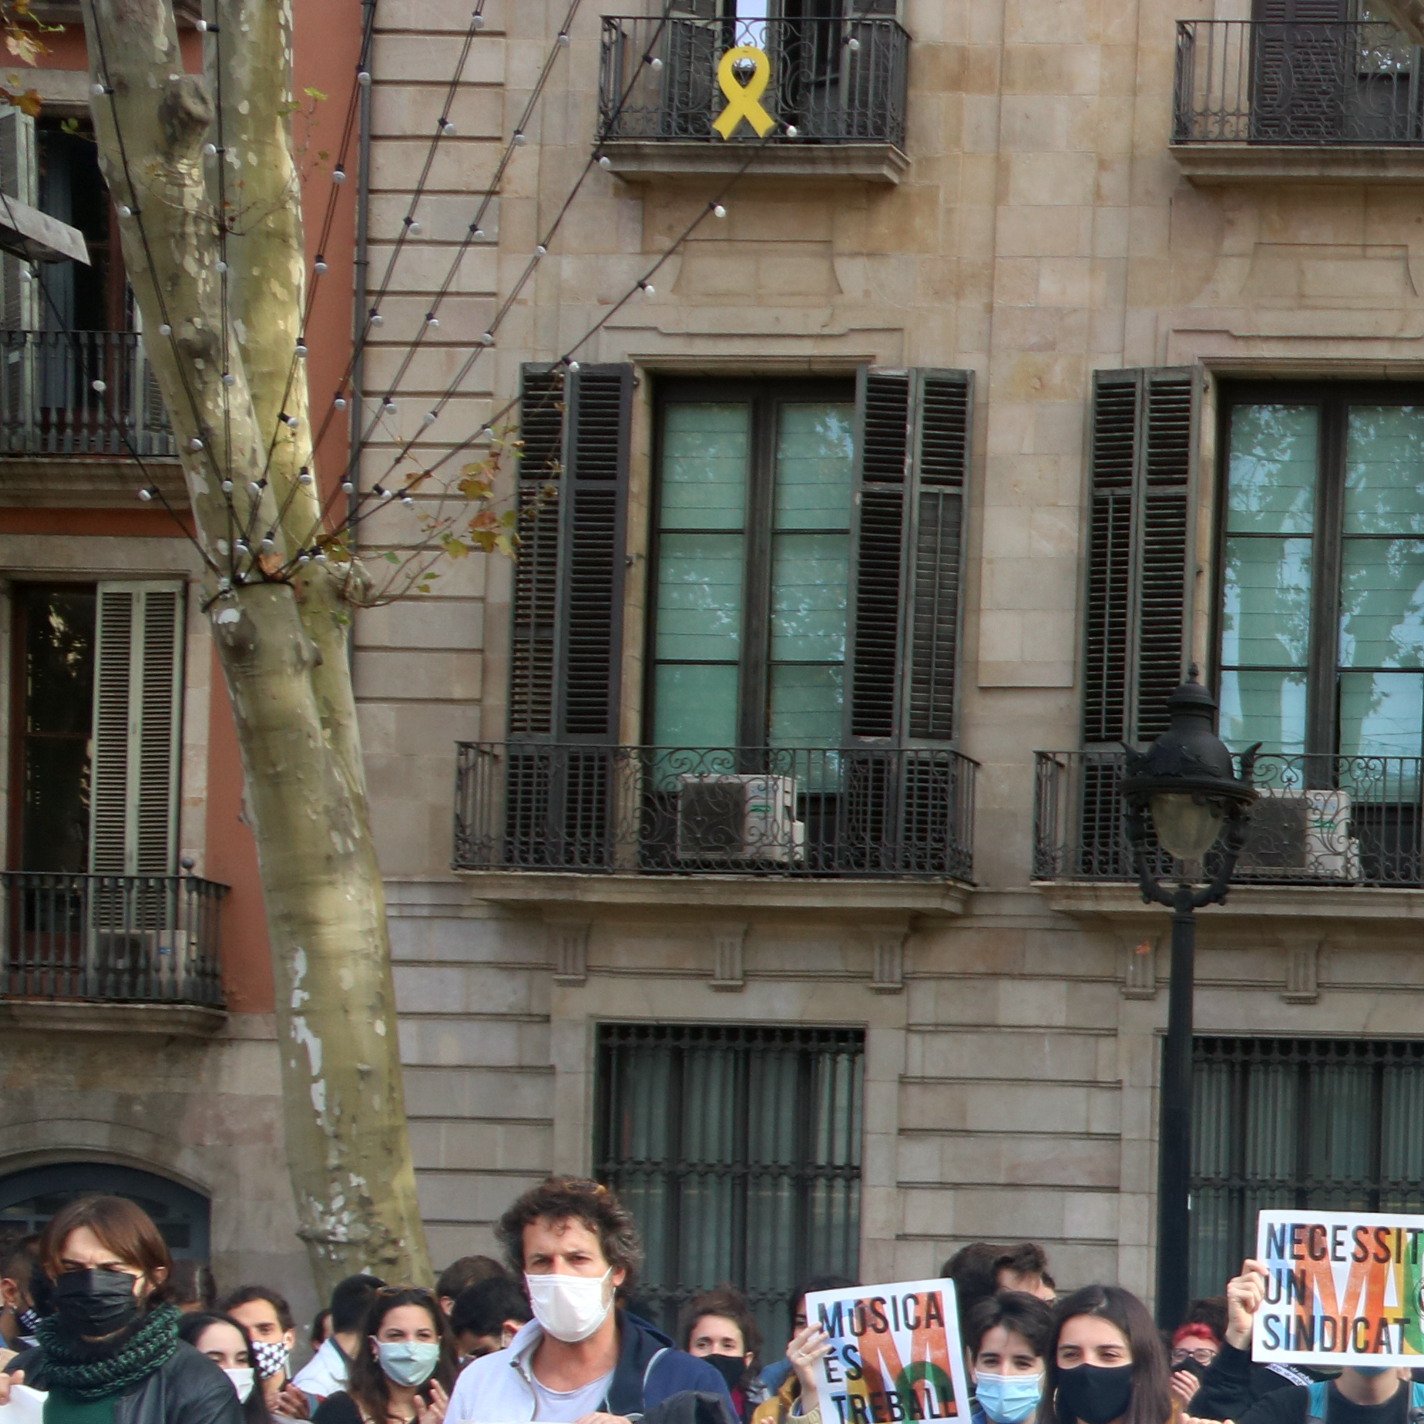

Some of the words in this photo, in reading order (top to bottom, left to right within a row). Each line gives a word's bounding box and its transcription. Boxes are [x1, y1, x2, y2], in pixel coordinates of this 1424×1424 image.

[1265, 1268, 1306, 1305] UN
[1262, 1314, 1411, 1354] SINDICAT
[822, 1344, 863, 1383] ÉS
